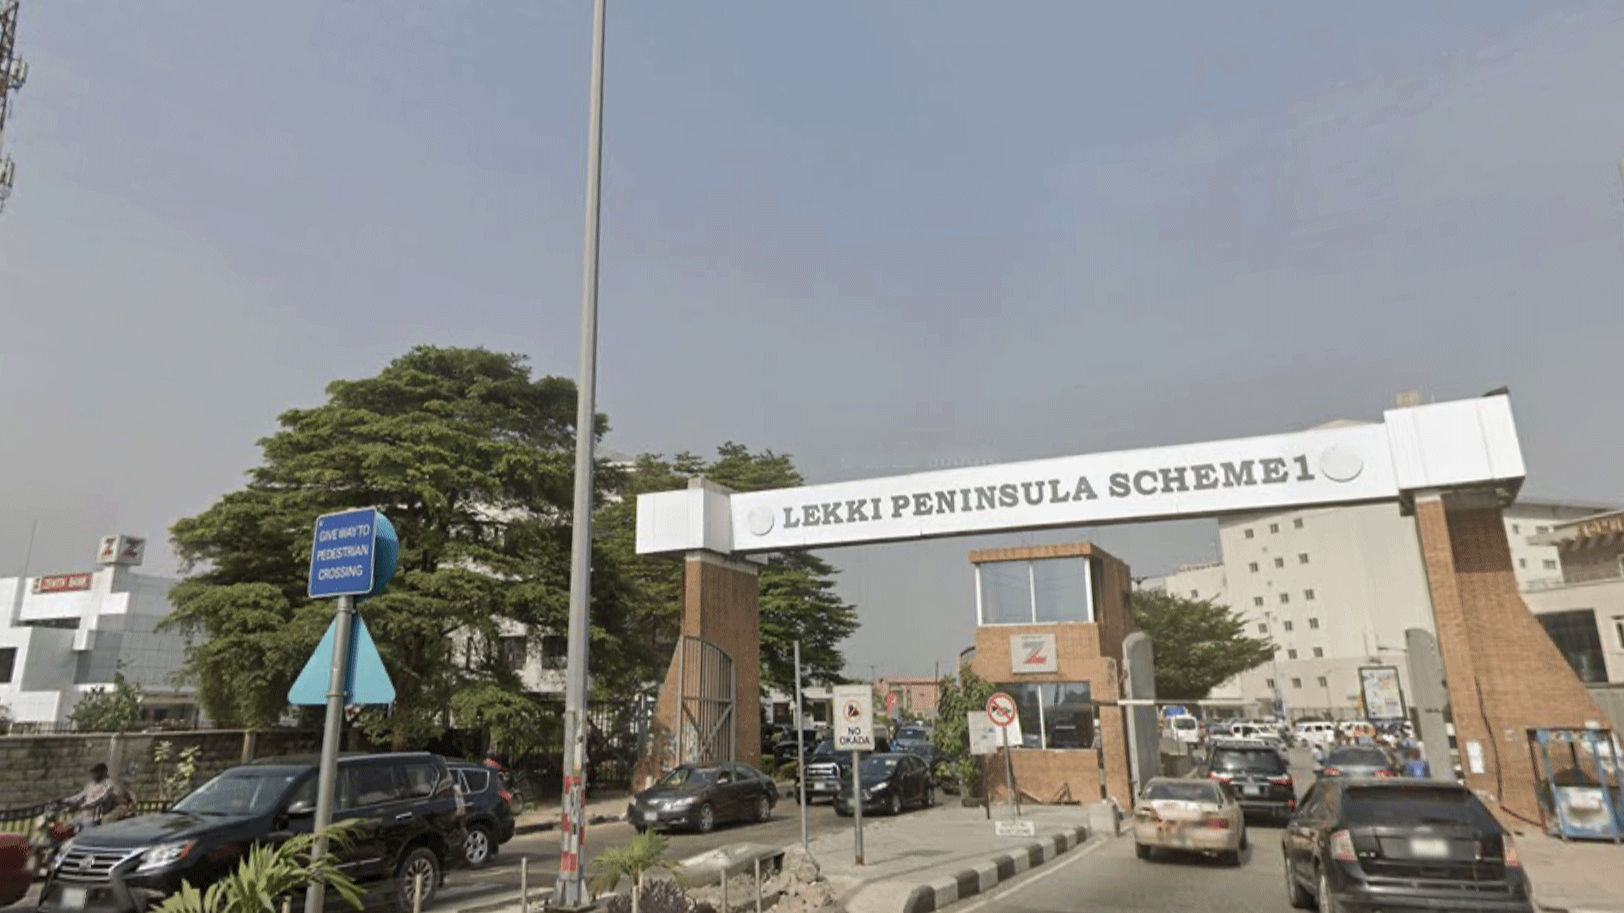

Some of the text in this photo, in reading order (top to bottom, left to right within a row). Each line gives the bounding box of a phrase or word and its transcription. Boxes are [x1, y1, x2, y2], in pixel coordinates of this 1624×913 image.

[783, 497, 883, 529] LEKKI
[890, 475, 1098, 518] PENINSULA
[319, 523, 370, 542] GIVE WAY TO
[316, 544, 370, 561] PEDESTRIAN
[318, 564, 363, 581] CROSSING
[847, 726, 861, 736] NO
[839, 735, 870, 746] OKADA
